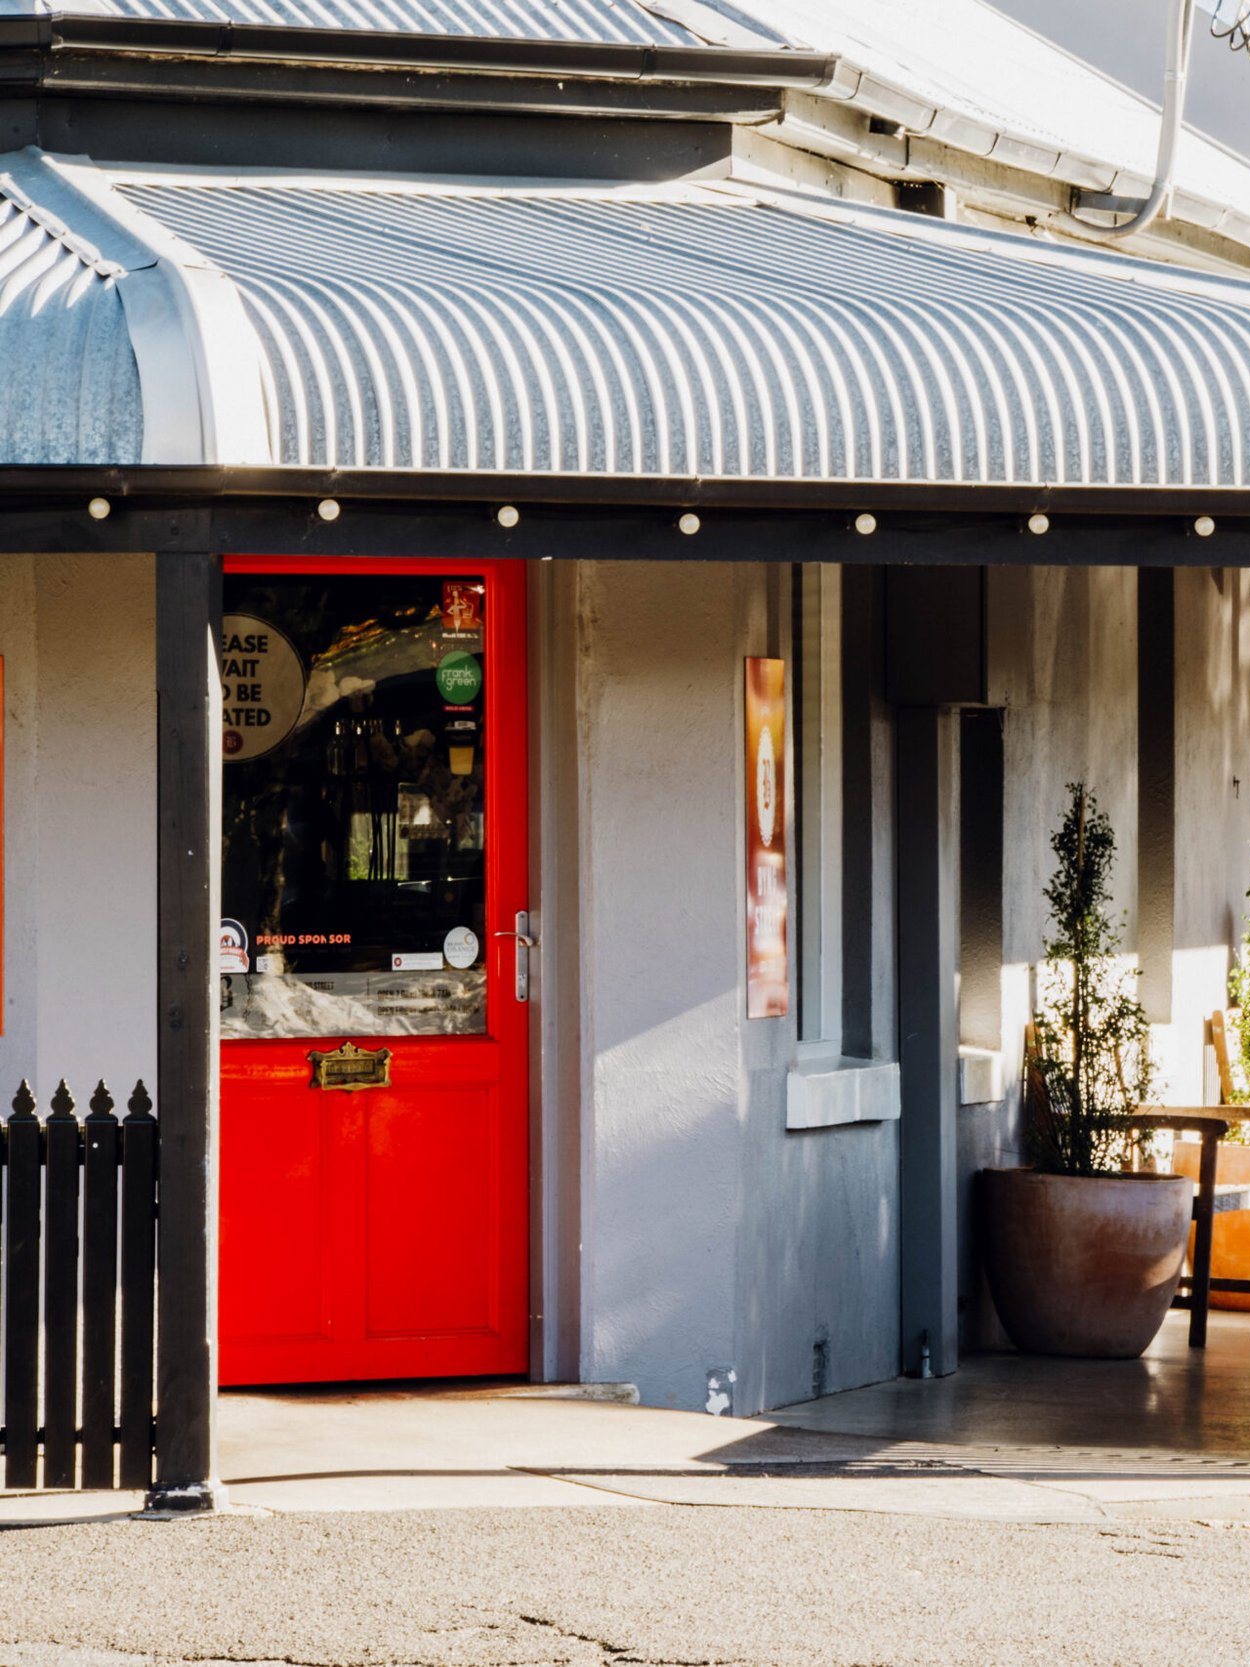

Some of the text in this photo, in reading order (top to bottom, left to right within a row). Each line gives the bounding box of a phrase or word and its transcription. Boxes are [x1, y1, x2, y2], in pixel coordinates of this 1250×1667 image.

[442, 666, 473, 682] frank
[446, 678, 477, 691] green
[237, 684, 262, 702] BE
[222, 709, 271, 726] ATED
[256, 934, 351, 945] PROUD SPONSOR
